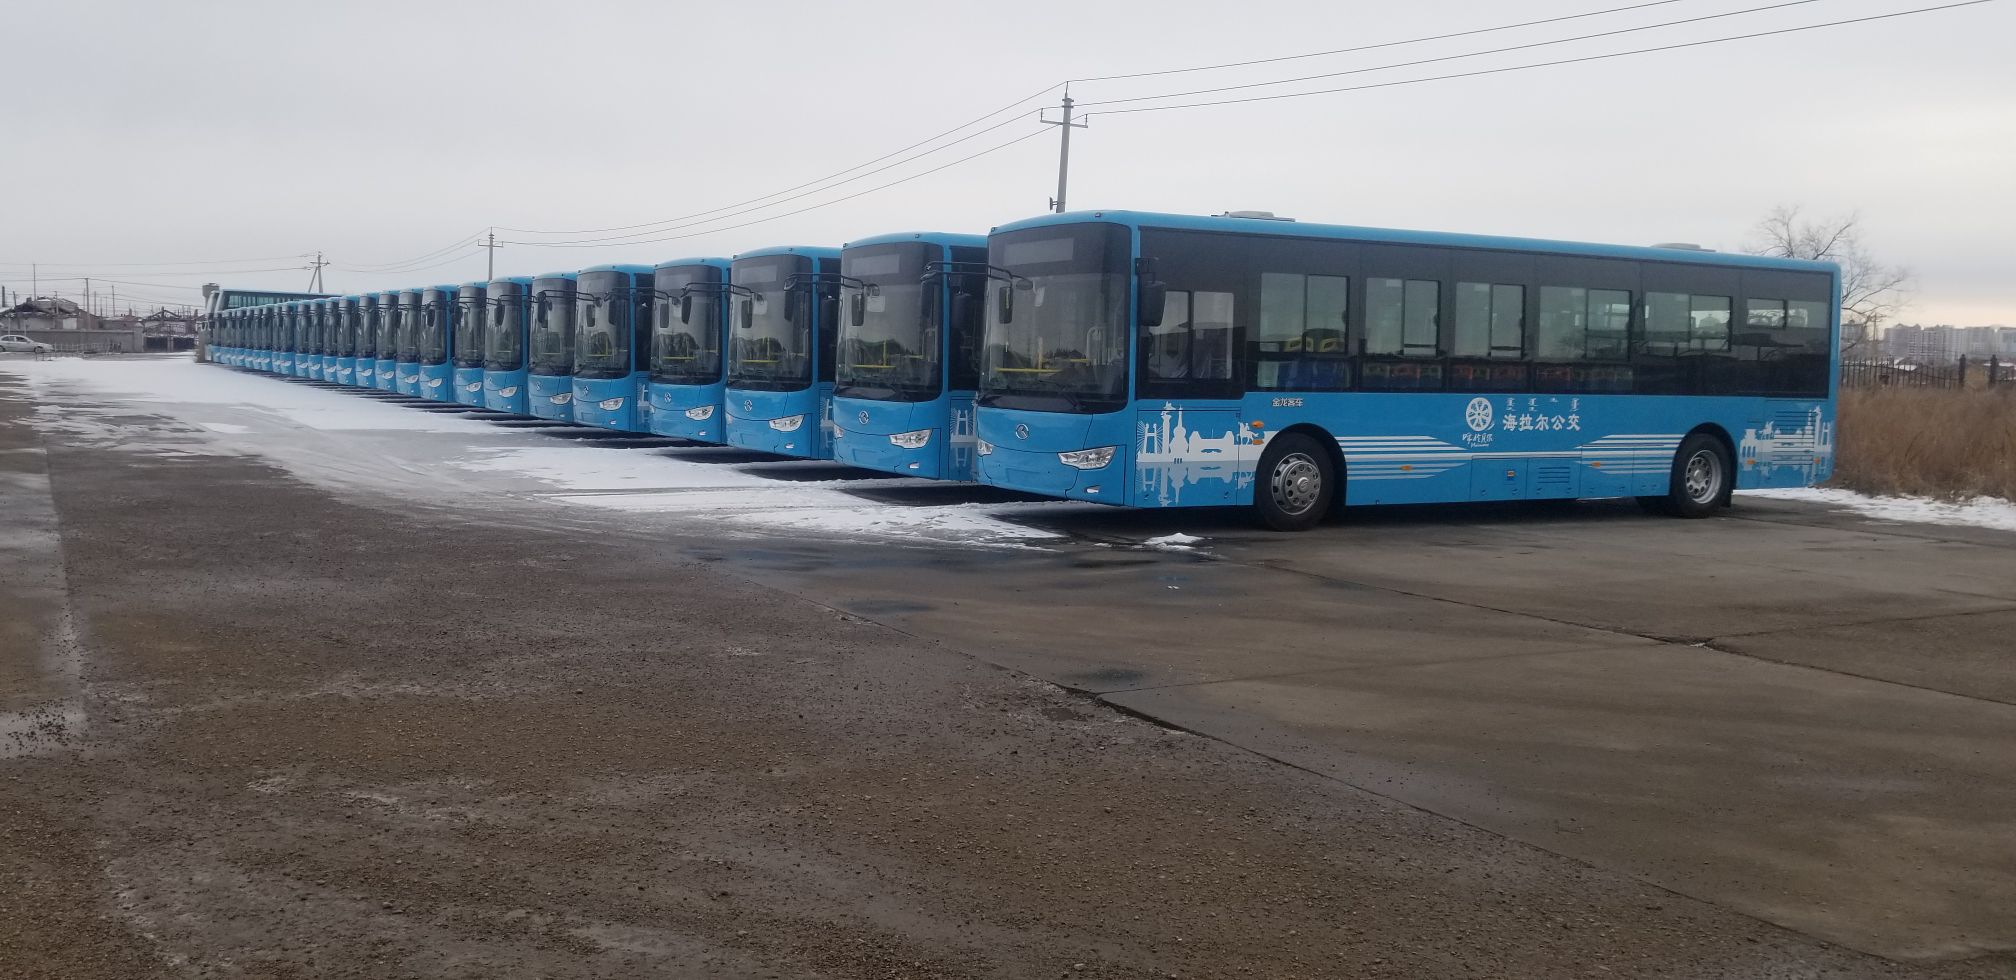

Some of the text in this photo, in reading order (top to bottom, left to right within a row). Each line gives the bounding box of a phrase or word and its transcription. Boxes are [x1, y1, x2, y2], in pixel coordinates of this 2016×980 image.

[1502, 413, 1581, 431] 海拉尔公交
